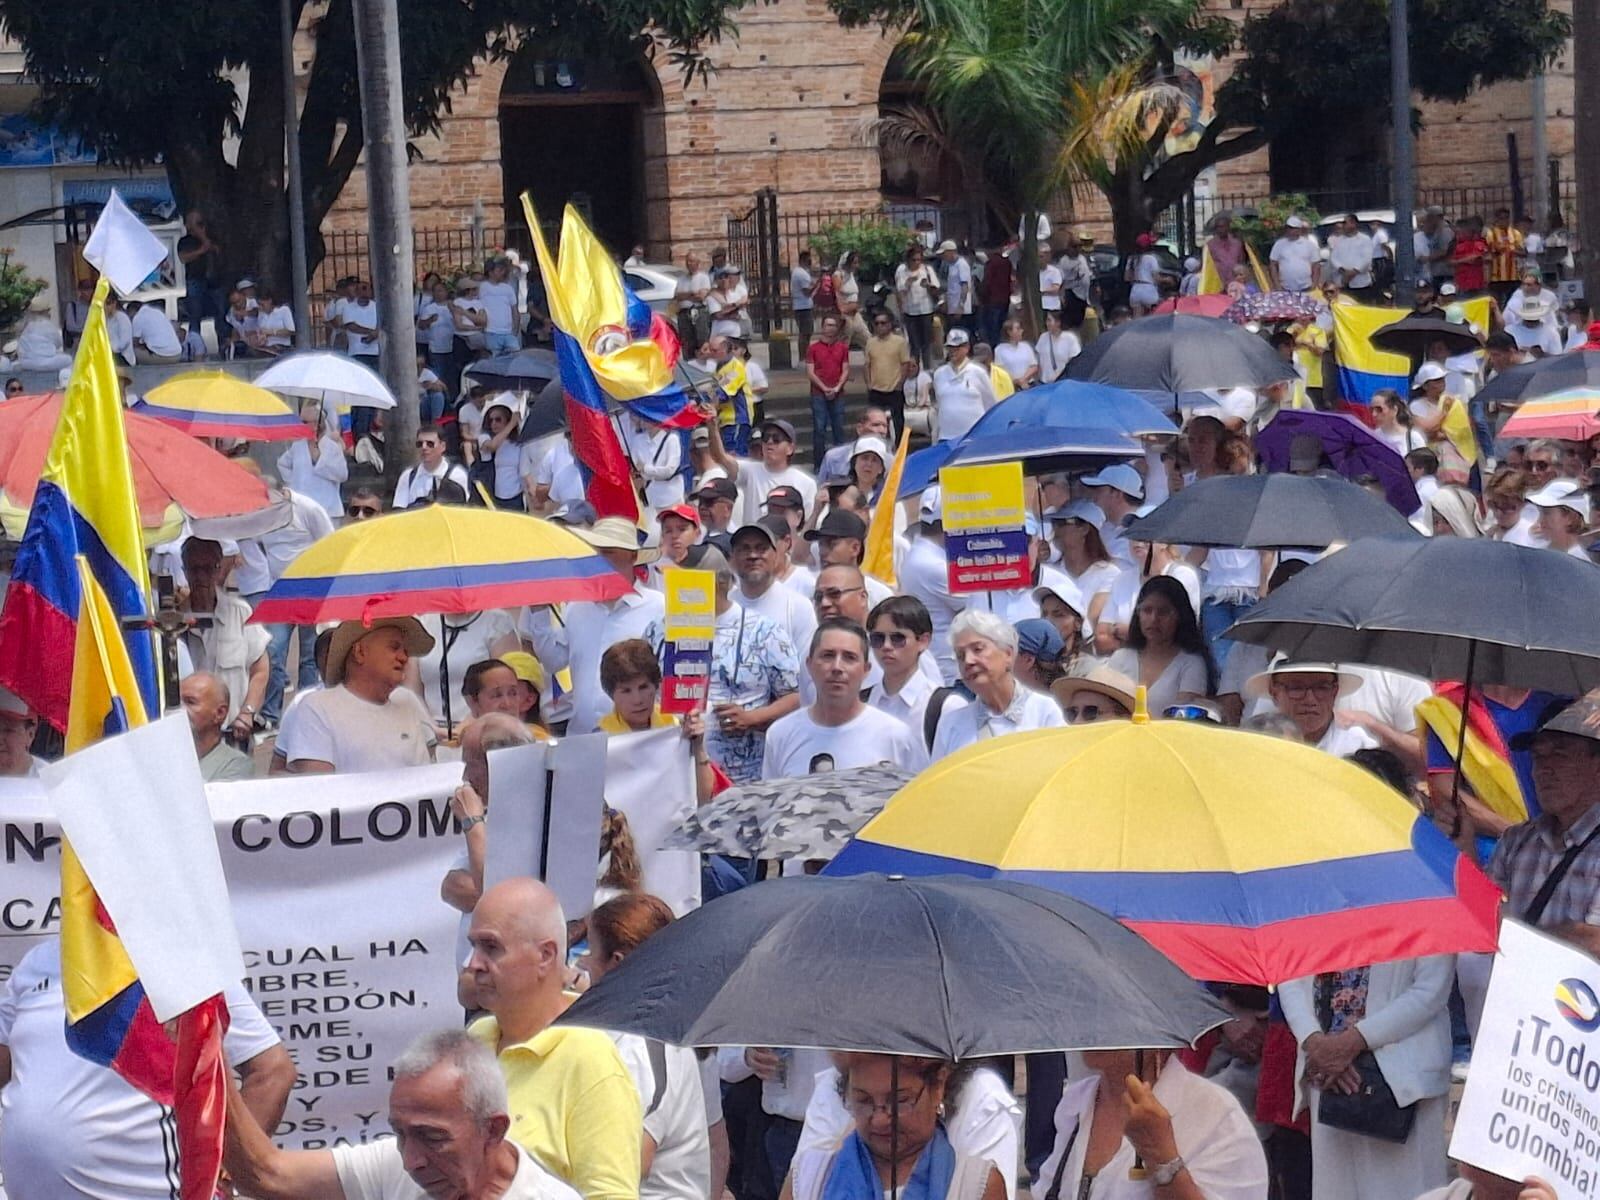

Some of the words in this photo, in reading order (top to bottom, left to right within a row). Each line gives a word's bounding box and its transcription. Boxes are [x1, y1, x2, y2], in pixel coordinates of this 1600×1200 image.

[369, 938, 429, 959] HA
[316, 1043, 373, 1063] SU
[1507, 1059, 1533, 1088] los
[296, 1095, 322, 1112] Y
[1501, 1088, 1570, 1137] unidos
[354, 1111, 380, 1126] Y
[1488, 1112, 1598, 1200] Colombia!
